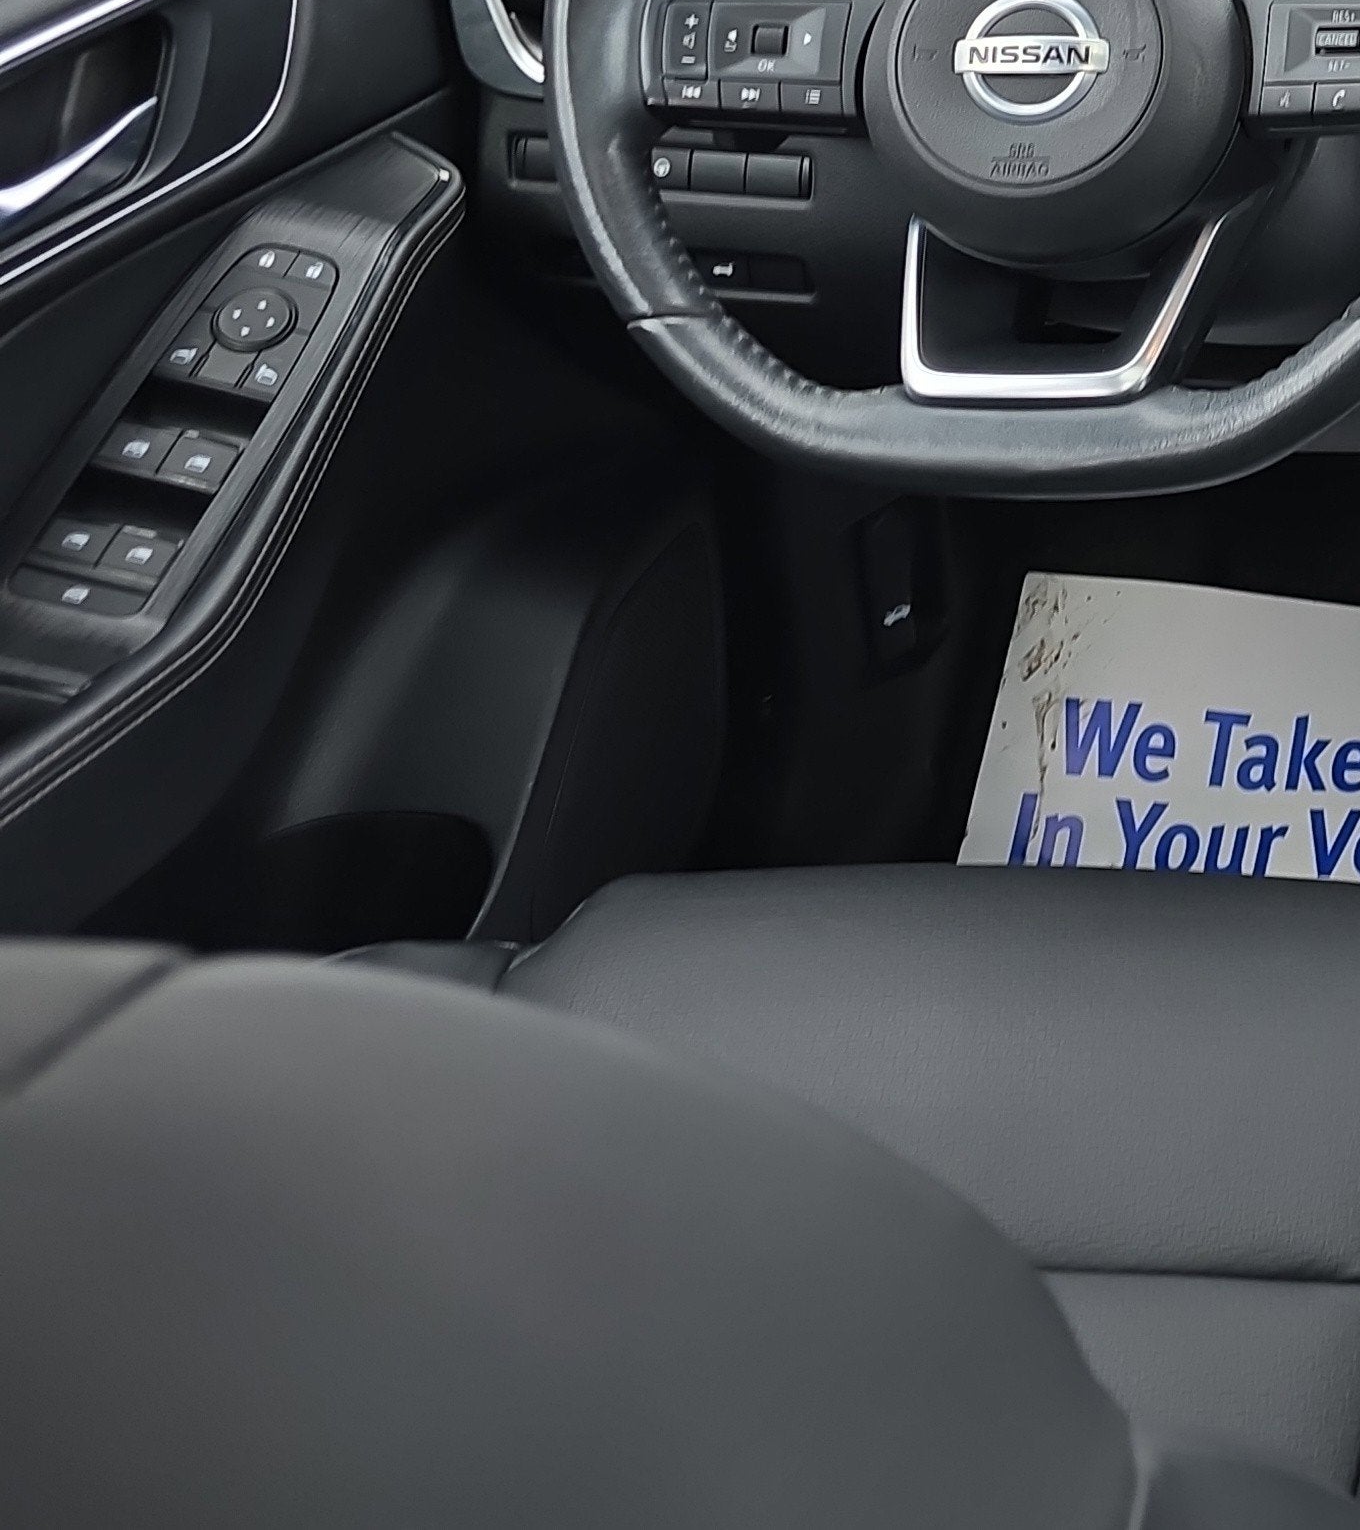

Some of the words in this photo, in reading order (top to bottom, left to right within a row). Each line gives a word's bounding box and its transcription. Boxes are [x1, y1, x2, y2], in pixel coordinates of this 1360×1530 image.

[1317, 32, 1360, 47] CANCEL
[758, 58, 776, 72] OK
[968, 45, 1091, 65] NISSAN
[1063, 697, 1176, 781] We
[1006, 792, 1084, 866] In
[1115, 798, 1290, 878] Your
